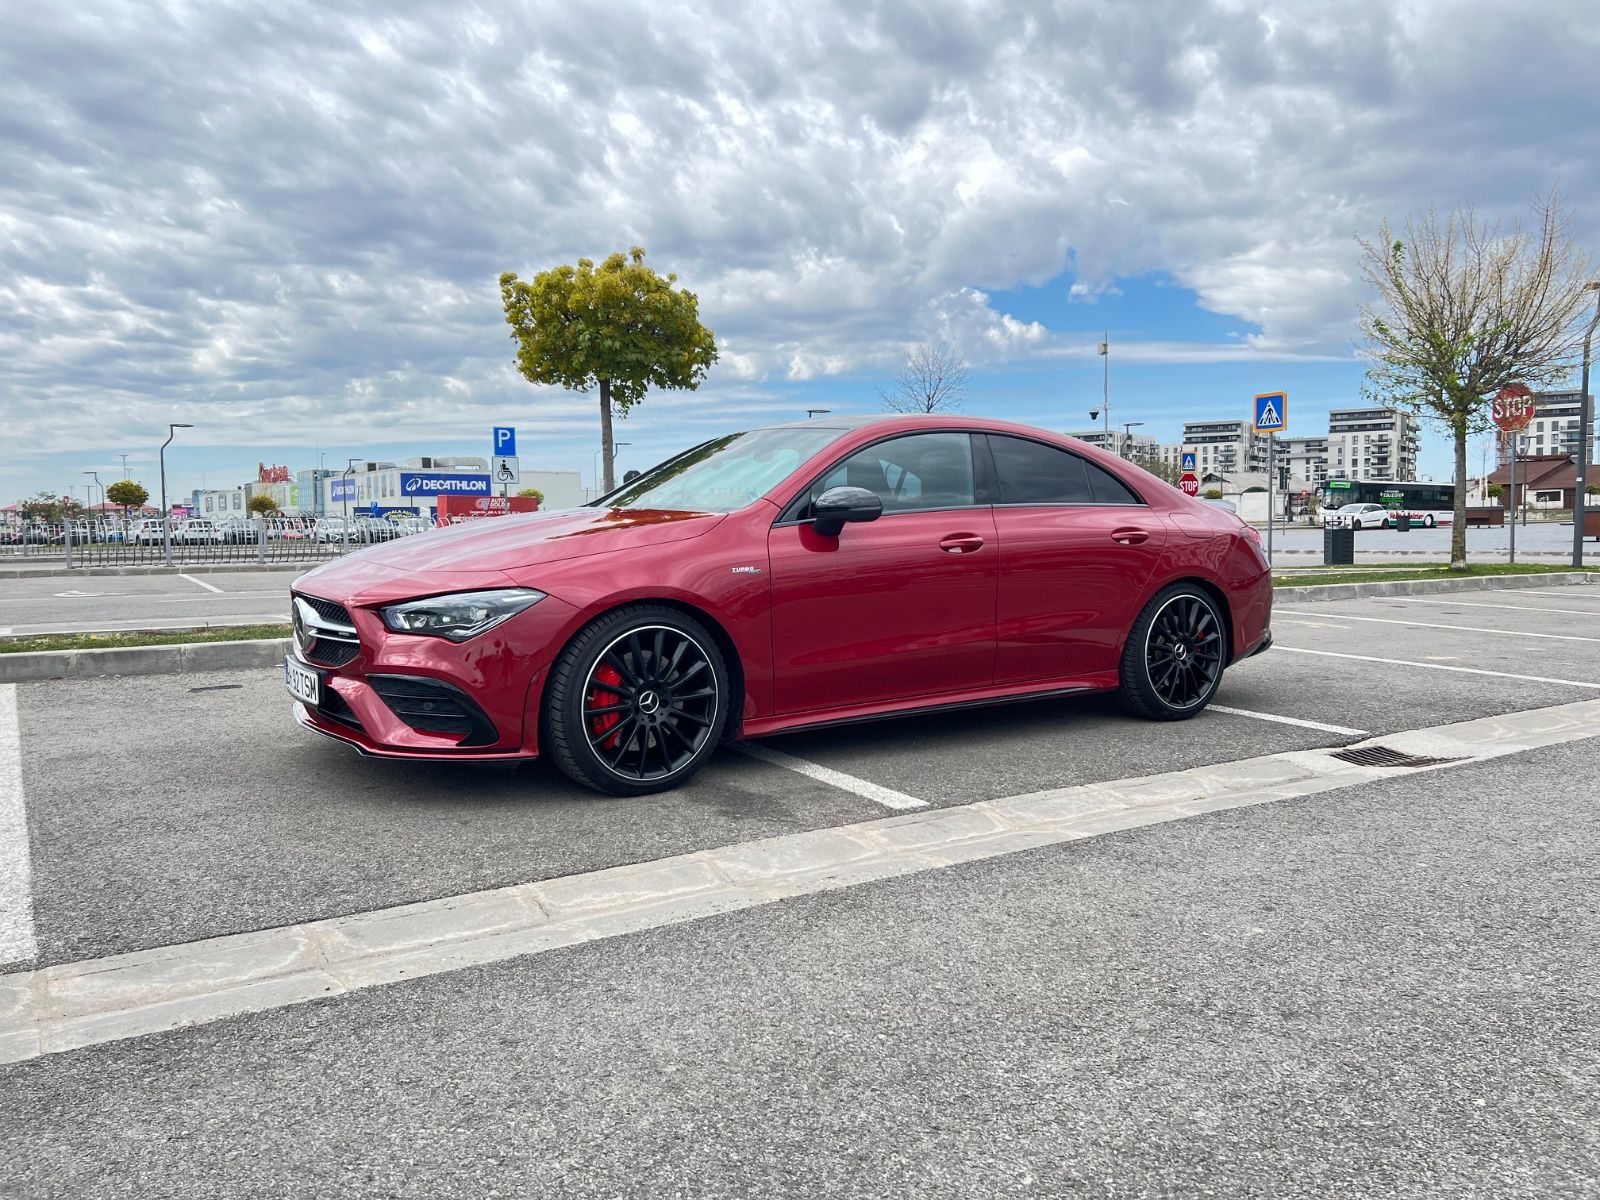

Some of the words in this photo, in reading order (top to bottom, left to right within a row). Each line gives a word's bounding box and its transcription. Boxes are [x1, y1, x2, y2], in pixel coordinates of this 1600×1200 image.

[1493, 395, 1532, 419] STOP
[498, 429, 511, 448] P
[422, 479, 487, 491] DECATHLON
[1179, 480, 1198, 492] STOP
